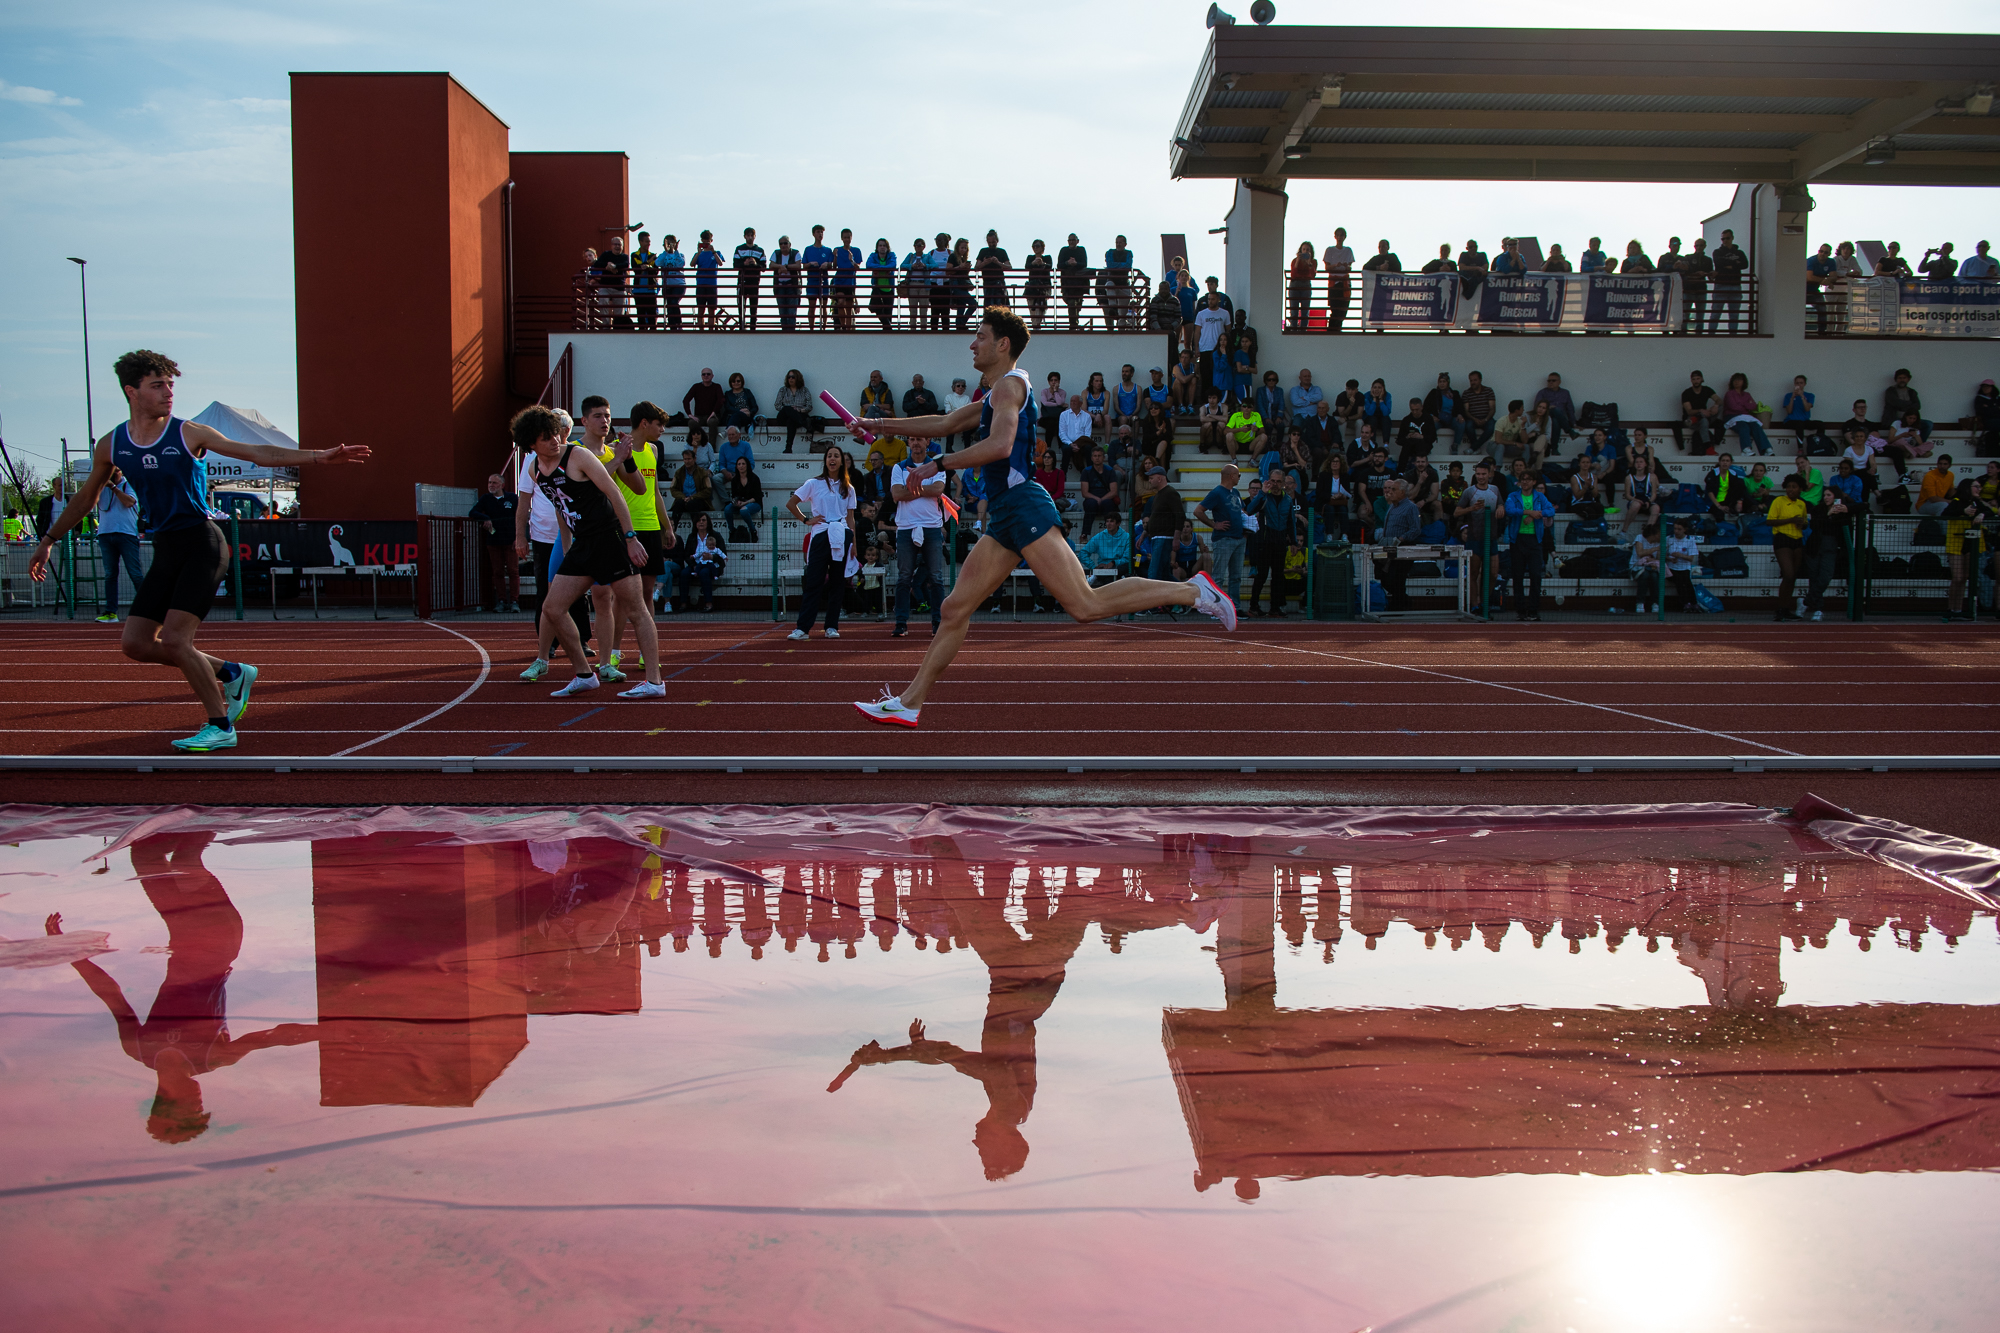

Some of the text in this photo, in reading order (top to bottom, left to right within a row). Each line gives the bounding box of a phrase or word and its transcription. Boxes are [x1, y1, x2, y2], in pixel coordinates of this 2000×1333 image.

[1381, 276, 1437, 287] SAN FILIPPO
[1488, 277, 1543, 289] SAN FILIPPO
[1595, 277, 1649, 289] SAN FILIPPO
[1391, 290, 1435, 301] RUNNERS
[1920, 284, 1950, 294] icaro
[1952, 284, 1981, 296] sport
[1499, 291, 1541, 302] RUNNERS
[1606, 292, 1648, 303] RUNNERS
[1392, 304, 1432, 316] BRESCIA
[1500, 305, 1538, 318] BRESCIA
[1607, 306, 1645, 319] BRESCIA
[740, 553, 755, 561] 262
[1425, 588, 1436, 596] 23
[1612, 588, 1623, 596] 28
[1723, 588, 1733, 596] 31
[1761, 588, 1771, 596] 32
